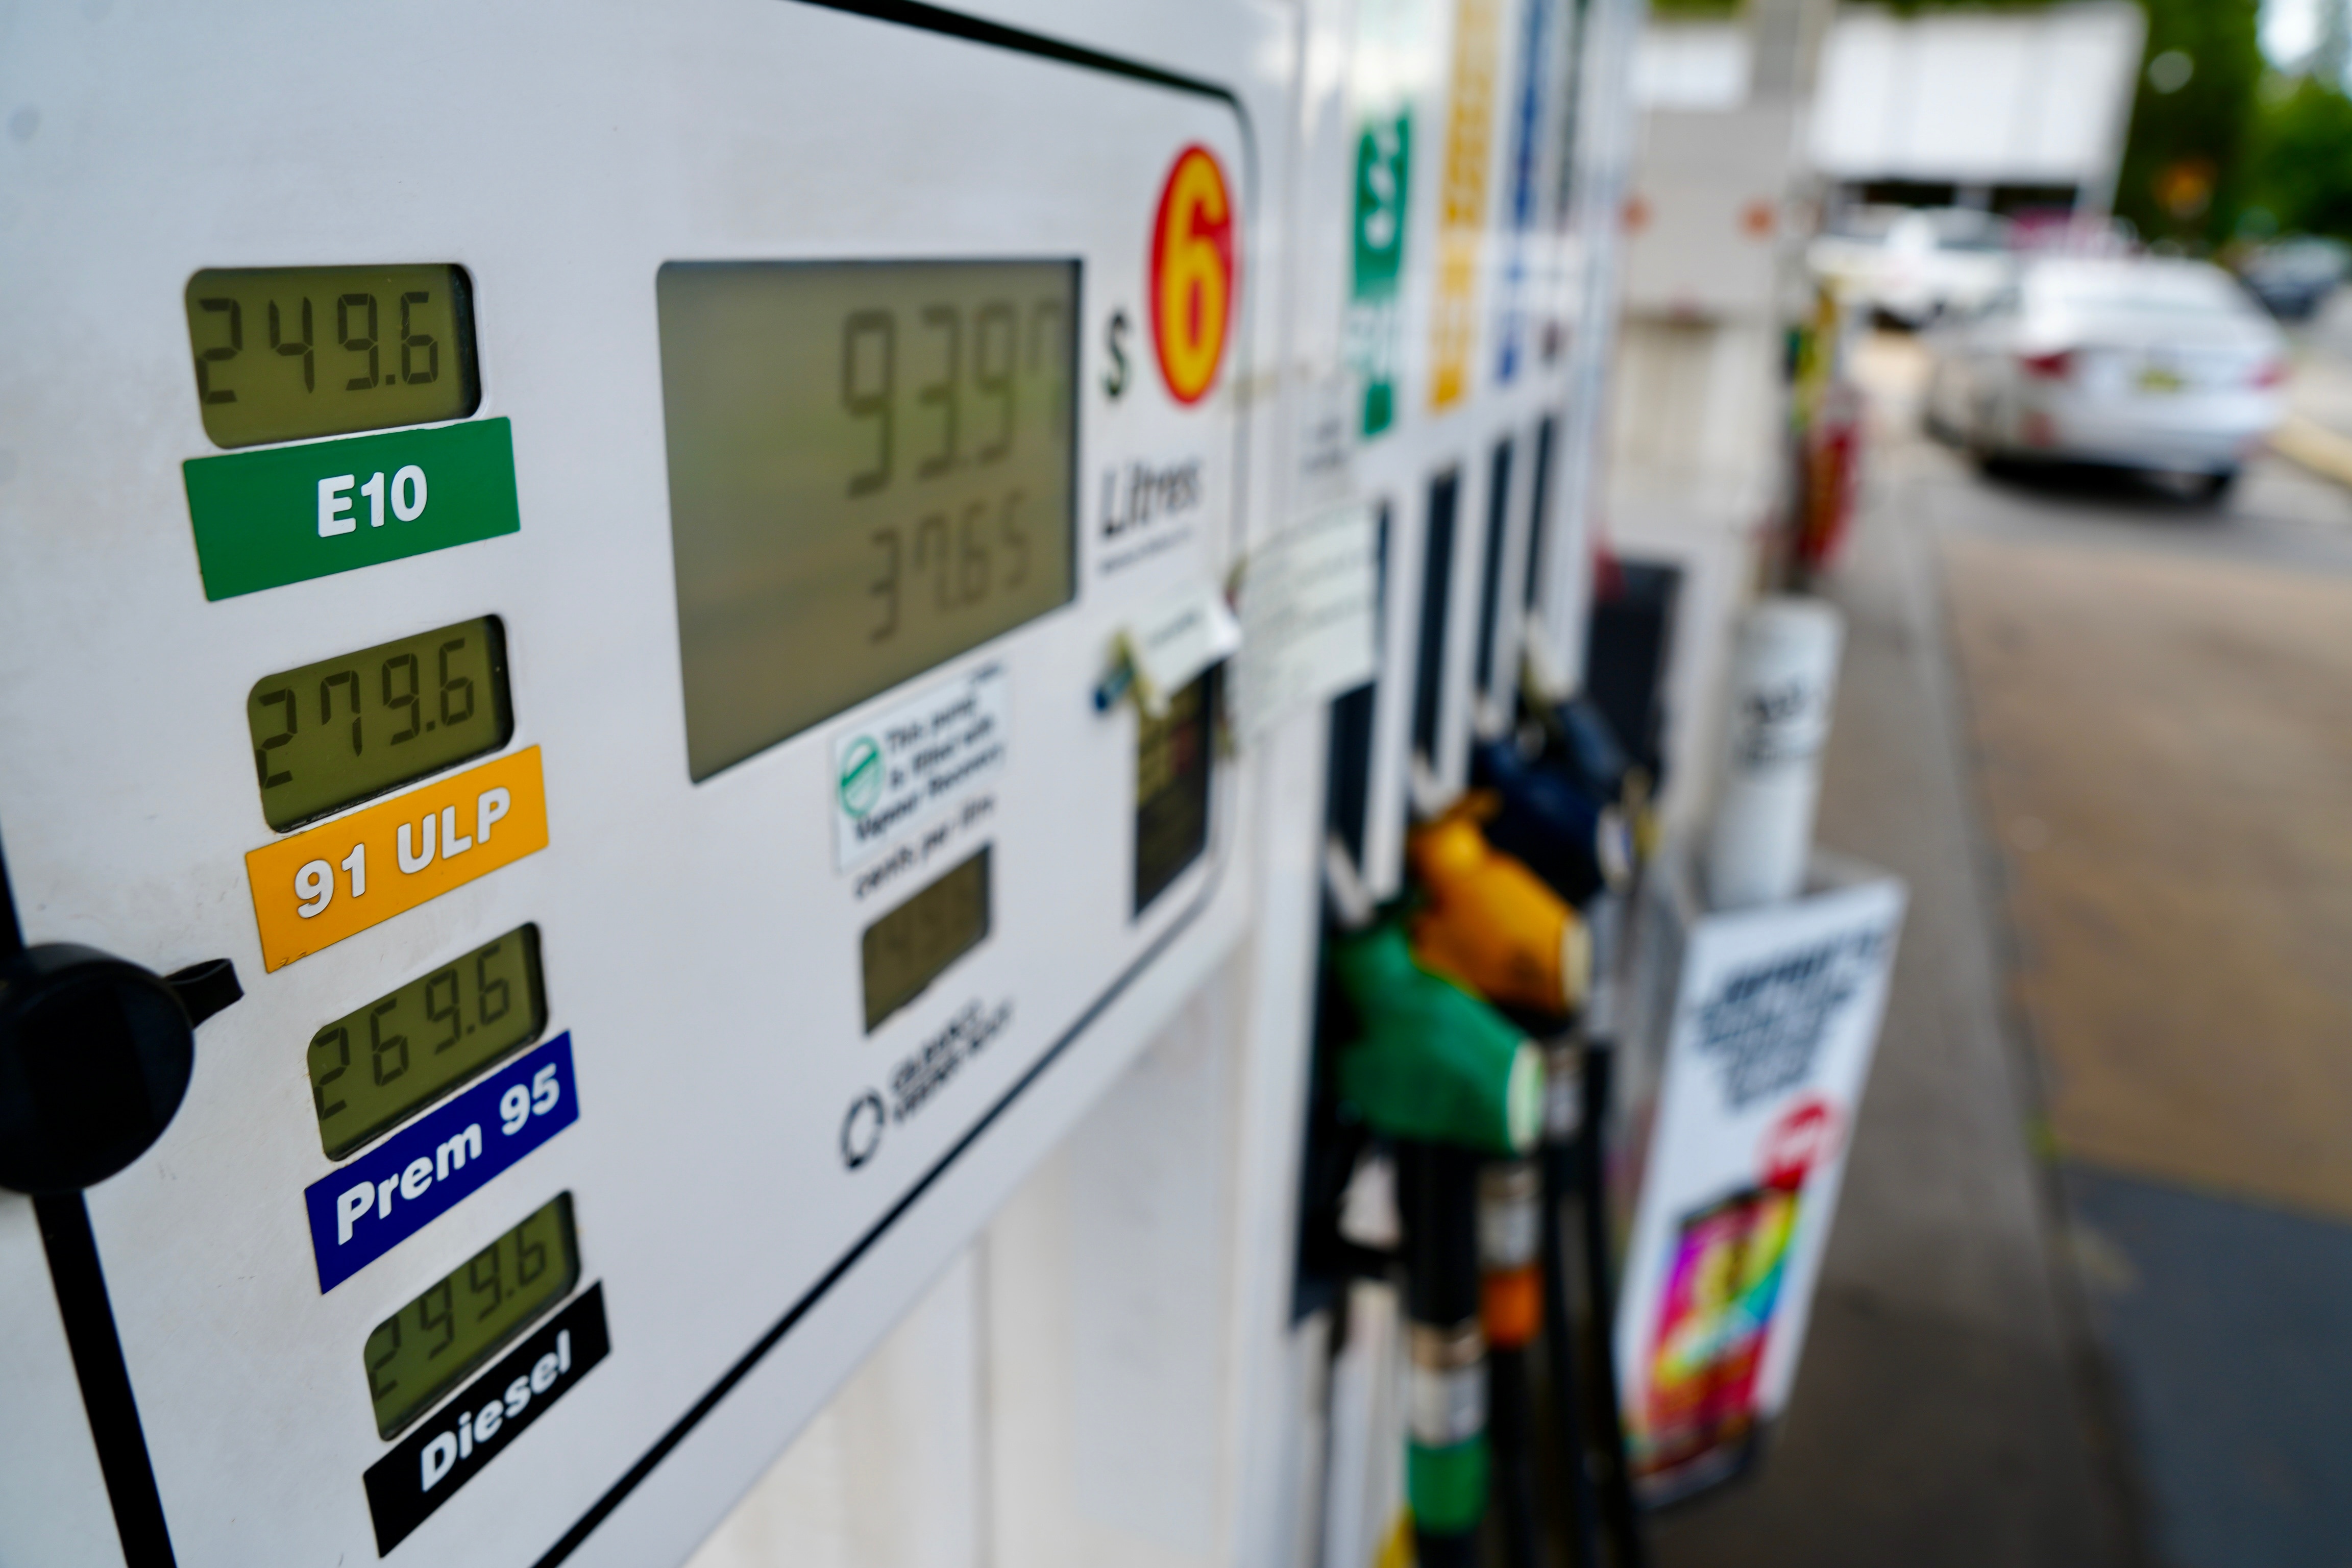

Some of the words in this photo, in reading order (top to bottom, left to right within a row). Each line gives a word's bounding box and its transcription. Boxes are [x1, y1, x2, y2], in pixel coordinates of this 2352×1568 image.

[197, 290, 438, 405] 249.6
[1163, 155, 1227, 400] 6
[317, 464, 428, 538] E10
[255, 638, 475, 790] 279.6
[293, 842, 366, 919] 91
[396, 786, 511, 875] ULP
[312, 944, 511, 1122] 269.6
[336, 1122, 483, 1246] Prem
[499, 1063, 560, 1136] 95
[420, 1328, 572, 1492] Diesel
